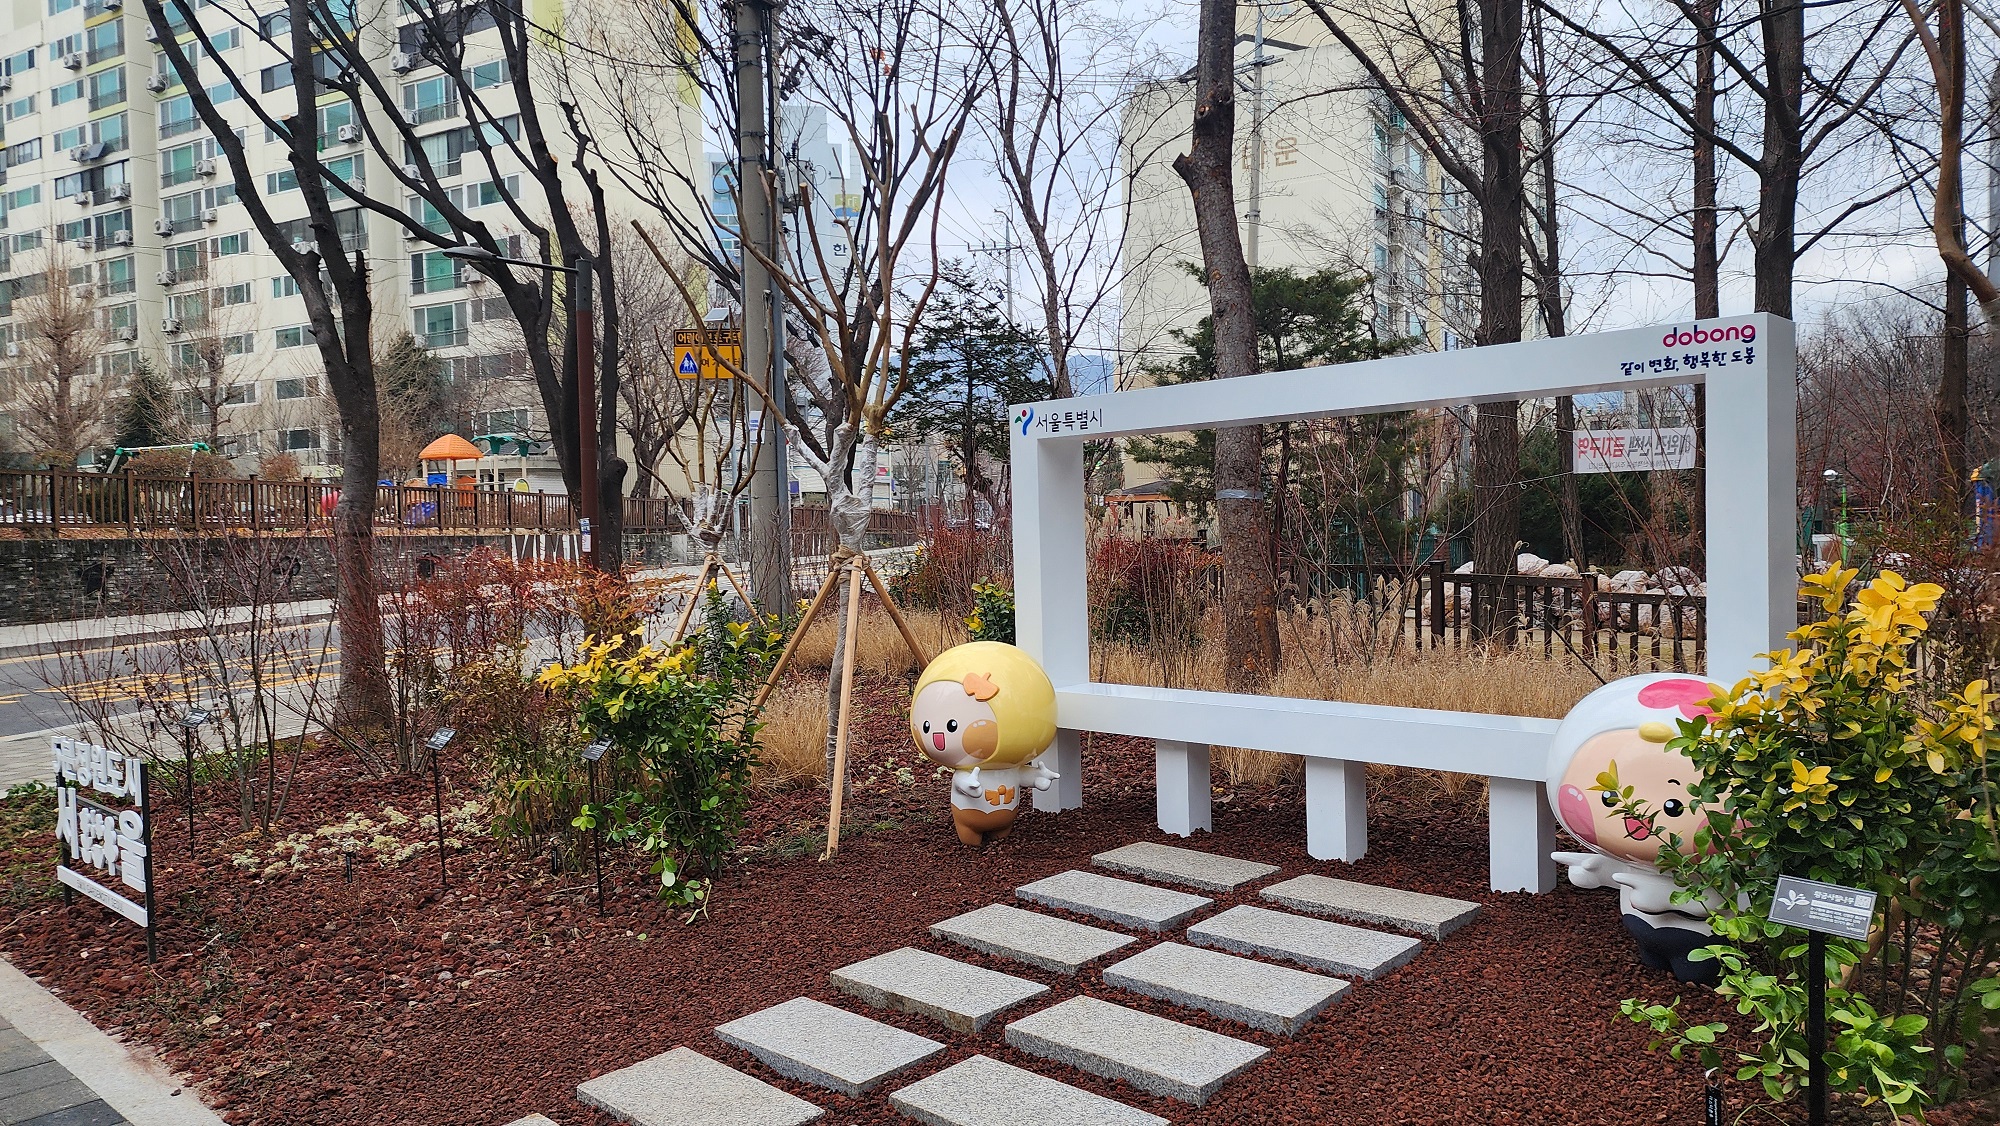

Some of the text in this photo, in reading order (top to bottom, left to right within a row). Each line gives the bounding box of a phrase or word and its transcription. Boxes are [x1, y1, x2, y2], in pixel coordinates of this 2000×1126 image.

[1662, 324, 1756, 348] dobong
[1620, 346, 1756, 376] 같이 변화, 행복한 도봉
[1036, 408, 1103, 433] 서울특별시
